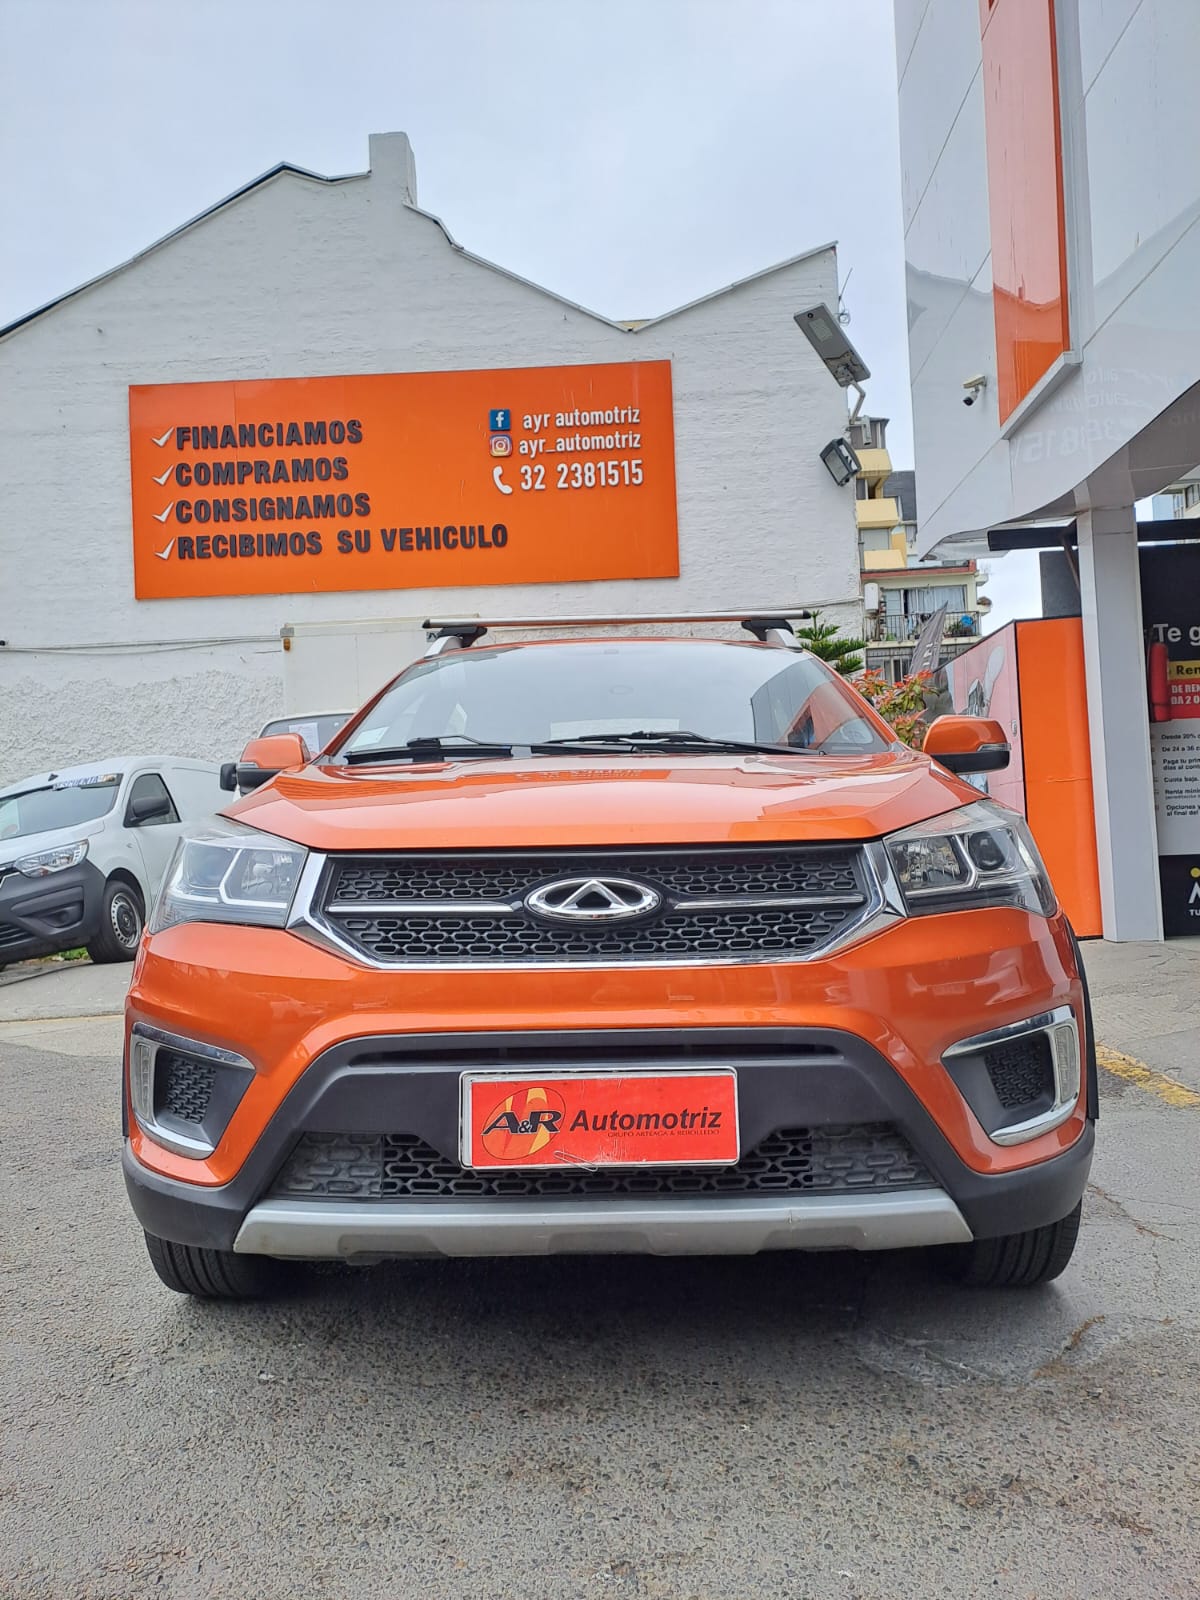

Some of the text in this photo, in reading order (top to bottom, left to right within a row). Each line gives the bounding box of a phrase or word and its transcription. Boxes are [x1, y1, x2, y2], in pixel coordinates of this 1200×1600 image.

[523, 406, 640, 433] ayr automotriz
[176, 420, 363, 450] FINANCIAMOS
[519, 431, 641, 459] ayr_automotriz
[175, 457, 349, 487] COMPRAMOS
[520, 459, 644, 491] 32 2381515
[175, 493, 371, 524] CONSIGNAMOS
[178, 523, 508, 560] RECIBIMOS SU VEHICULO
[1153, 623, 1182, 643] Te
[481, 1109, 562, 1136] A&R
[570, 1107, 722, 1132] Automotriz
